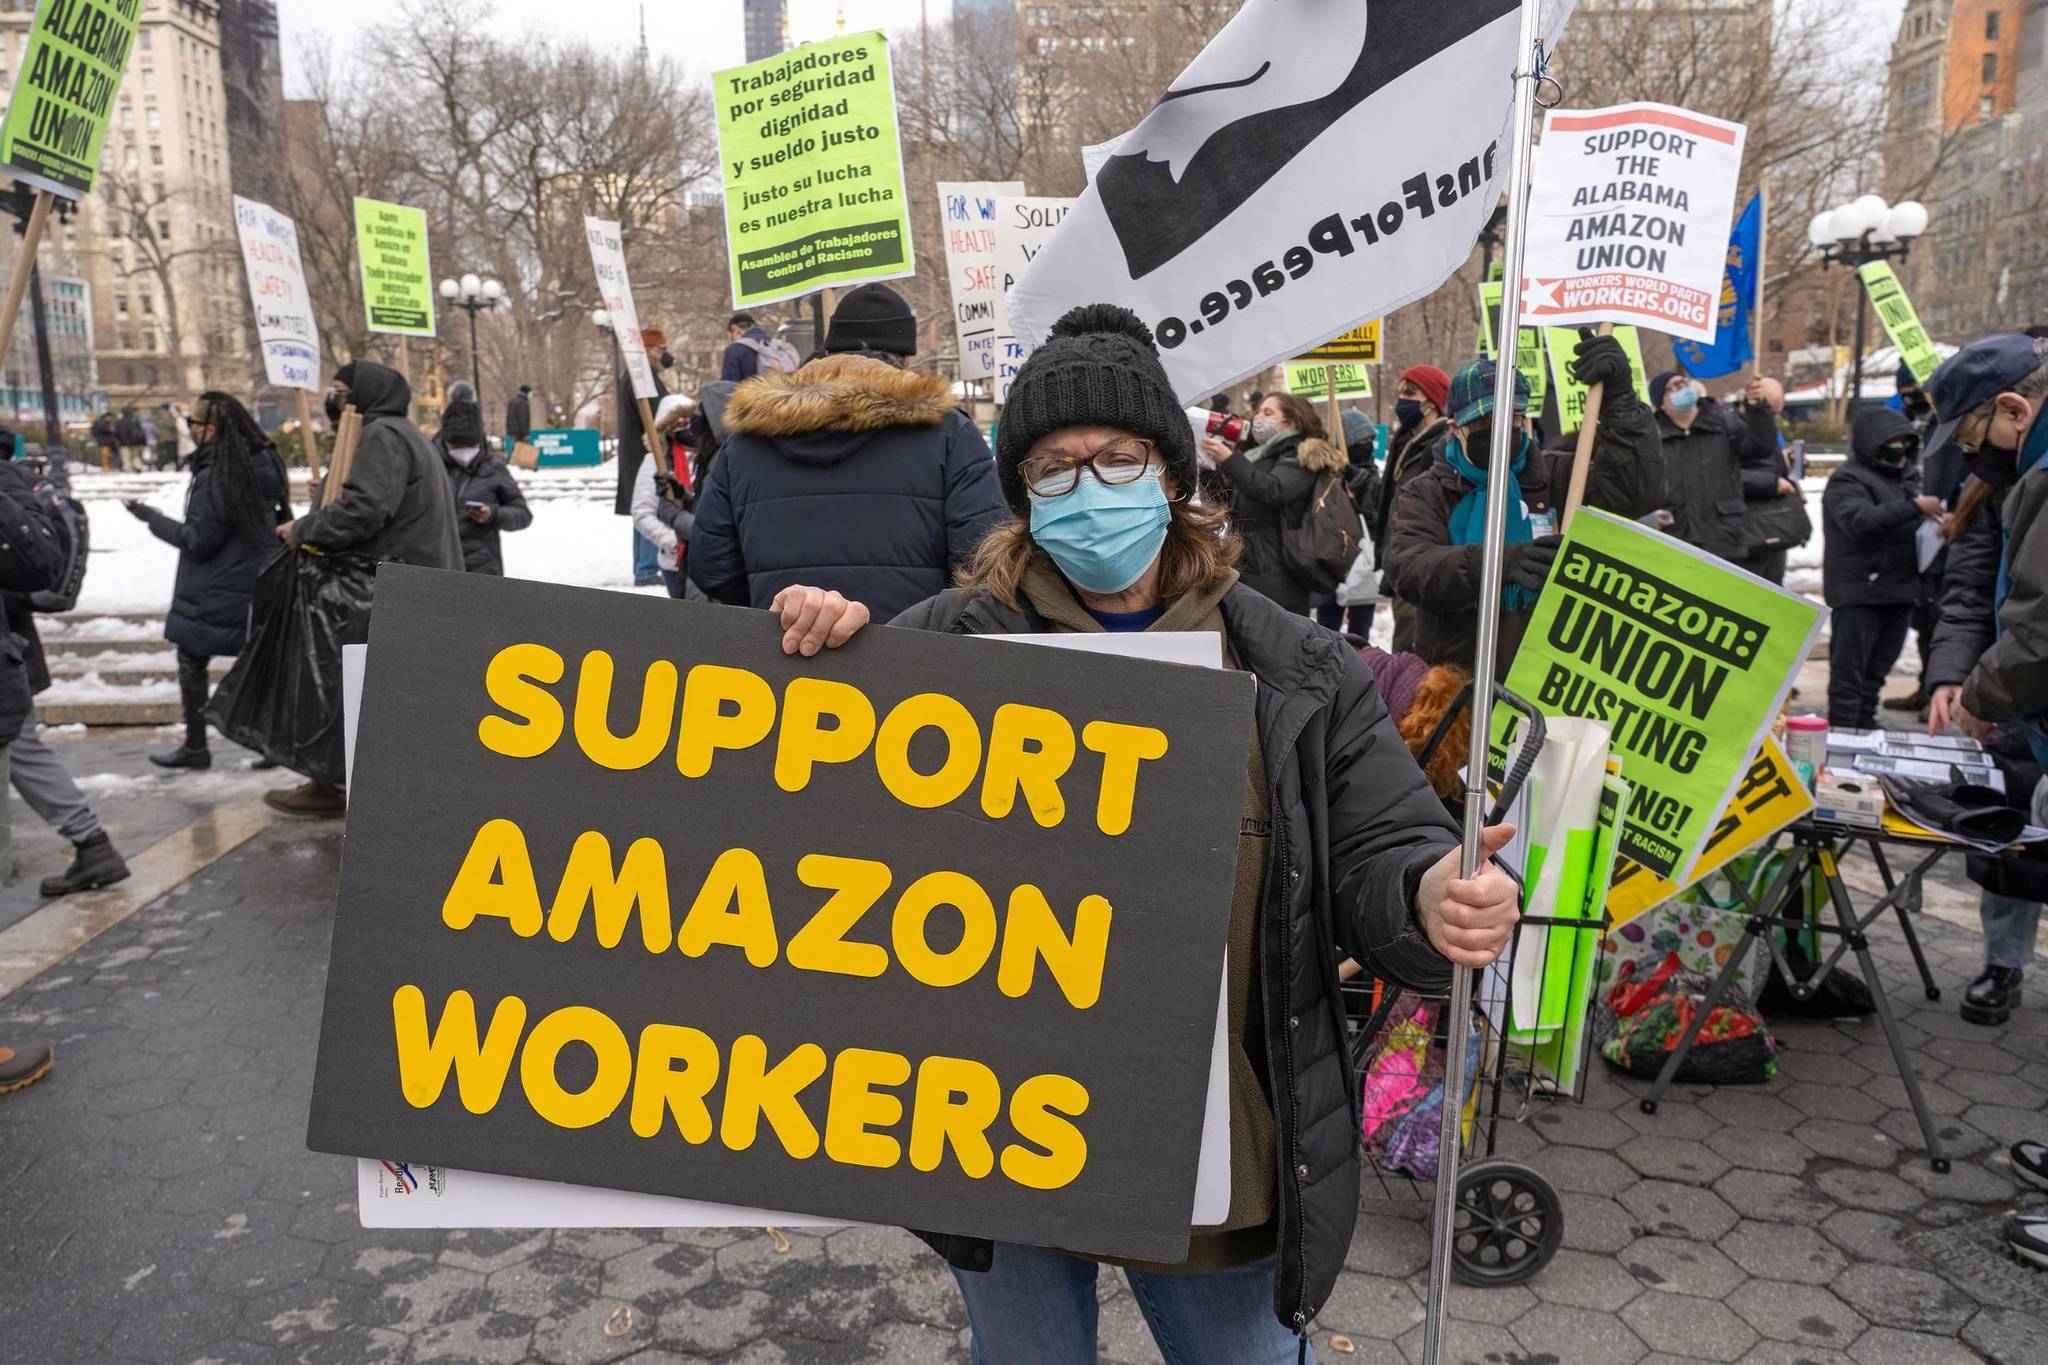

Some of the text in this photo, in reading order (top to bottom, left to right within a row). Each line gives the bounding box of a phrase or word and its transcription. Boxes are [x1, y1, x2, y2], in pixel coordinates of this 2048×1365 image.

[43, 0, 131, 72] ALABAMA
[28, 42, 116, 118] AMAZON
[730, 47, 868, 95] Trabajadores
[730, 65, 875, 122] por seguridad
[29, 97, 96, 160] UNON
[760, 99, 849, 139] dignidad
[732, 125, 880, 179] y sueldo justo
[1584, 129, 1698, 159] SUPPORT
[1616, 156, 1660, 177] THE
[739, 186, 893, 233] es nuestra lucha
[743, 164, 872, 210] justo su lucha
[947, 195, 971, 221] FOR
[1572, 181, 1689, 212] ALABAMA
[741, 227, 898, 271] Asamblea de Trabajadores
[1565, 213, 1686, 247] AMAZON
[767, 247, 873, 280] contra el Racismo
[1576, 244, 1667, 274] UNION
[1562, 288, 1706, 324] WORKERS.ORG
[1565, 274, 1708, 304] WORKERS WORLD PARTY
[1296, 364, 1357, 385] WORERS!
[1562, 552, 1759, 658] amazon:
[1547, 593, 1729, 721] UNION
[478, 642, 1168, 836] SUPPORT
[1537, 661, 1708, 775] BUSTING
[1632, 832, 1676, 864] RACISM
[442, 819, 1113, 1009] AMAZON
[393, 985, 1089, 1190] WORKERS
